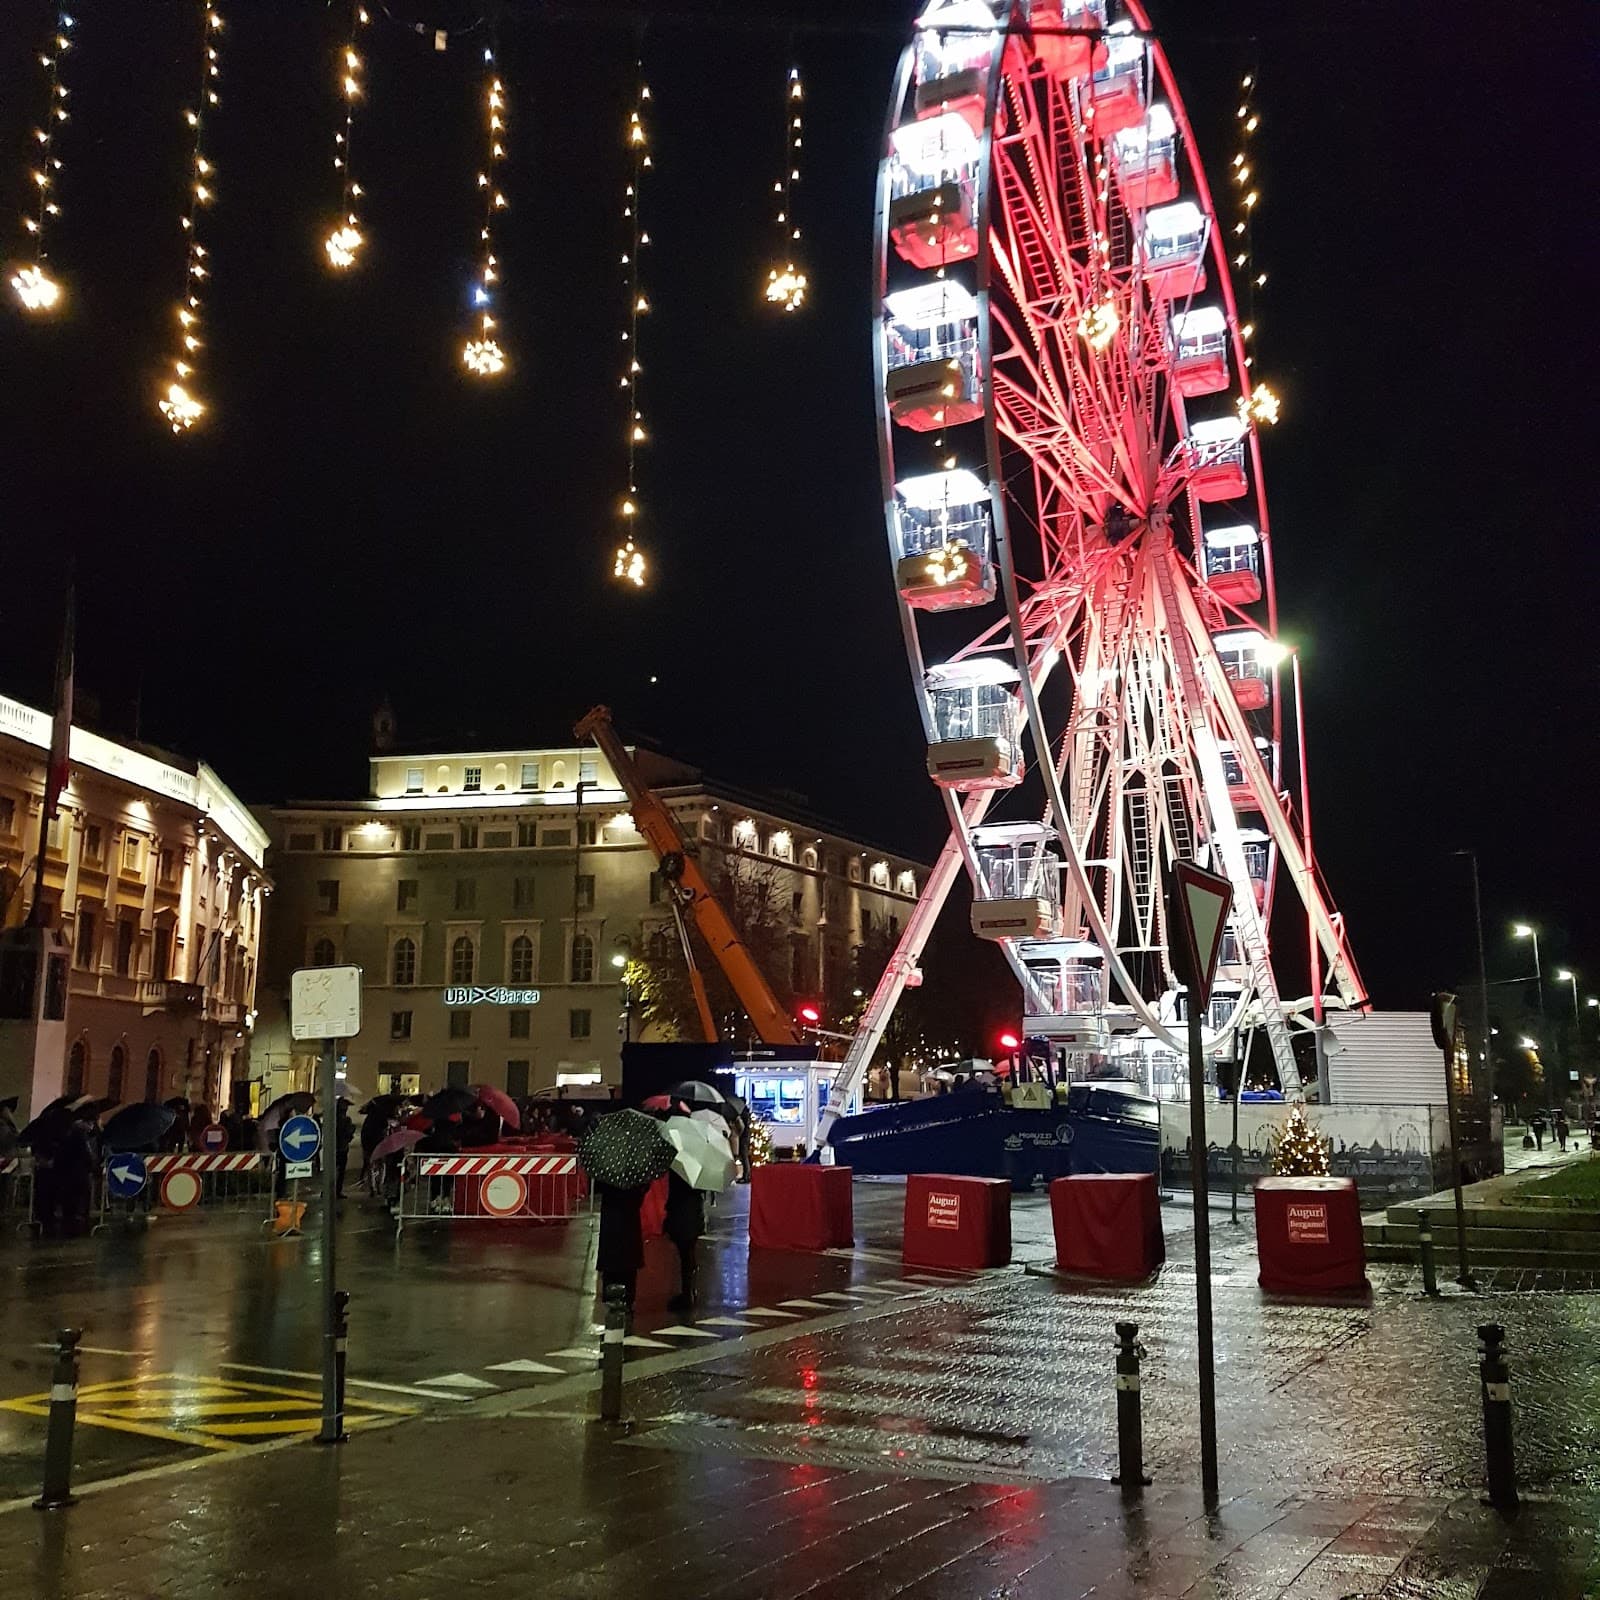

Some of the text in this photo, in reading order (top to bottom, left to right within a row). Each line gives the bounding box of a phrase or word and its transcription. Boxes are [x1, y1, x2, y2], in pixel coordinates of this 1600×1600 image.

[445, 986, 540, 1004] UBI Banca
[930, 1195, 957, 1207] Auguri
[1289, 1207, 1324, 1219] Auguri
